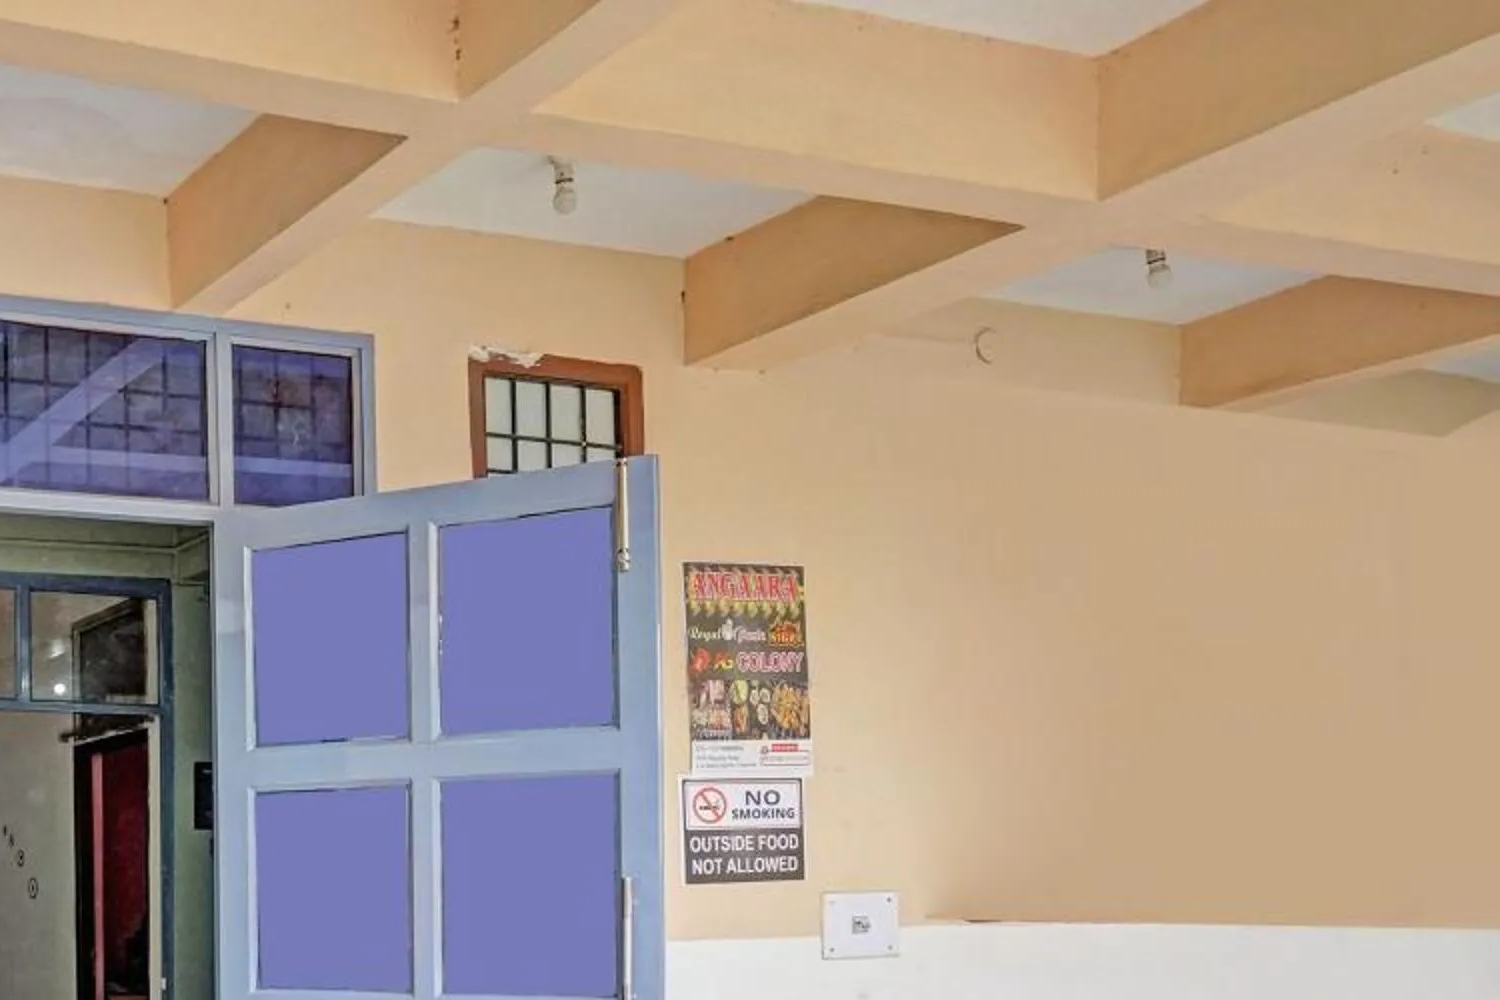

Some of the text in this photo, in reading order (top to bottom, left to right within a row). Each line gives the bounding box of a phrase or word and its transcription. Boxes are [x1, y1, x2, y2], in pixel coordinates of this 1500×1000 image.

[691, 571, 798, 601] ANGAARA
[736, 651, 804, 673] COLONY
[744, 789, 782, 806] NO
[731, 807, 796, 820] SMOKING
[689, 833, 799, 853] OUTSIDE FOOD
[691, 856, 799, 876] NOT ALLOWED
